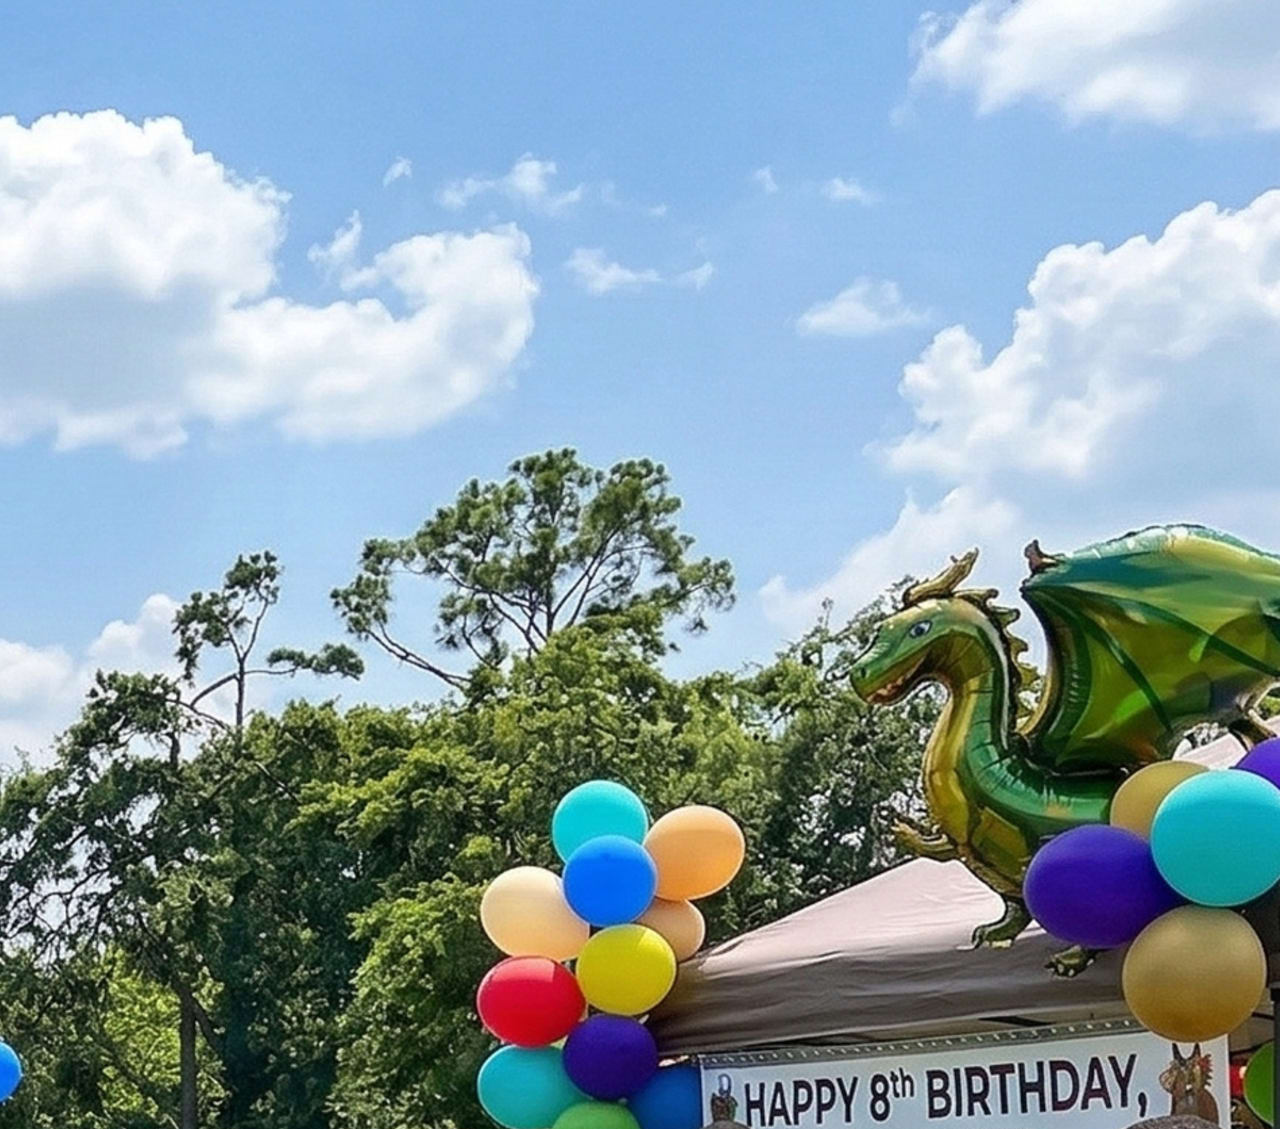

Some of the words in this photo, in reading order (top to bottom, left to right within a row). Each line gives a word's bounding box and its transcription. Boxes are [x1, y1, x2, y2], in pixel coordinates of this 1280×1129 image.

[744, 1076, 859, 1128] HAPPY
[869, 1067, 915, 1122] 8th
[926, 1053, 1148, 1119] BIRTHDAY,
